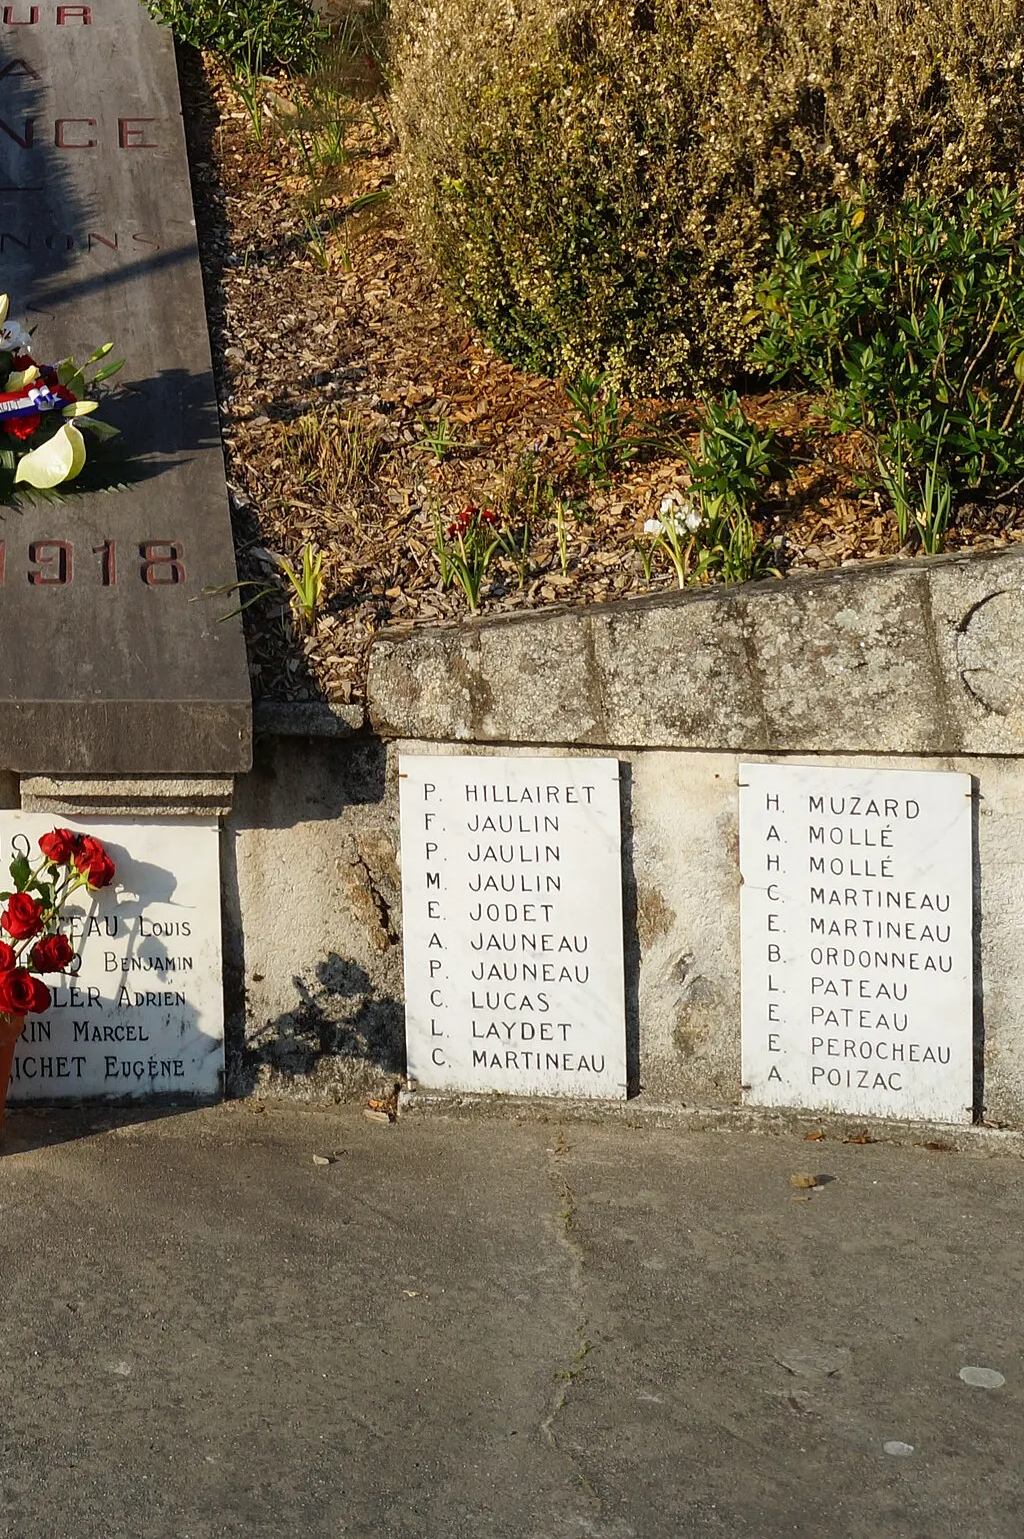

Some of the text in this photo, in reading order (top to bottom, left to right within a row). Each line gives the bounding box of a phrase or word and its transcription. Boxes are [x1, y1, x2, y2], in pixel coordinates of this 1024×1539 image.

[423, 783, 596, 805] P. HILLAIRET
[766, 792, 920, 820] H. MUZARD
[424, 812, 559, 834] F. JAULIN
[765, 823, 894, 848] A. MOLLÉ
[425, 842, 560, 864] P. JAULIN
[766, 853, 894, 878] H. MOLLÉ
[425, 871, 561, 893] M. JAULIN
[766, 883, 950, 913] C. MARTINEAU
[427, 900, 554, 923] E. JODET
[139, 918, 192, 937] LOUIS
[767, 913, 951, 943] E. MARTINEAU
[427, 932, 588, 954] A. JAUNEAU
[103, 951, 193, 972] BENJAMIN
[767, 943, 953, 973] B. ORDONNEAU
[429, 959, 589, 984] P. JAUNEAU
[117, 986, 186, 1008] ADRIEN
[768, 974, 908, 1002] L. PATEAU
[429, 989, 550, 1013] C. LUCAS
[768, 1003, 908, 1032] E. PATEAU
[73, 1021, 149, 1042] MARCEL
[430, 1018, 572, 1042] L. LAYDET
[431, 1047, 605, 1074] C. MARTINEAU
[768, 1033, 951, 1065] E. PEROCHEAU
[767, 1065, 903, 1092] A. POIZAC
